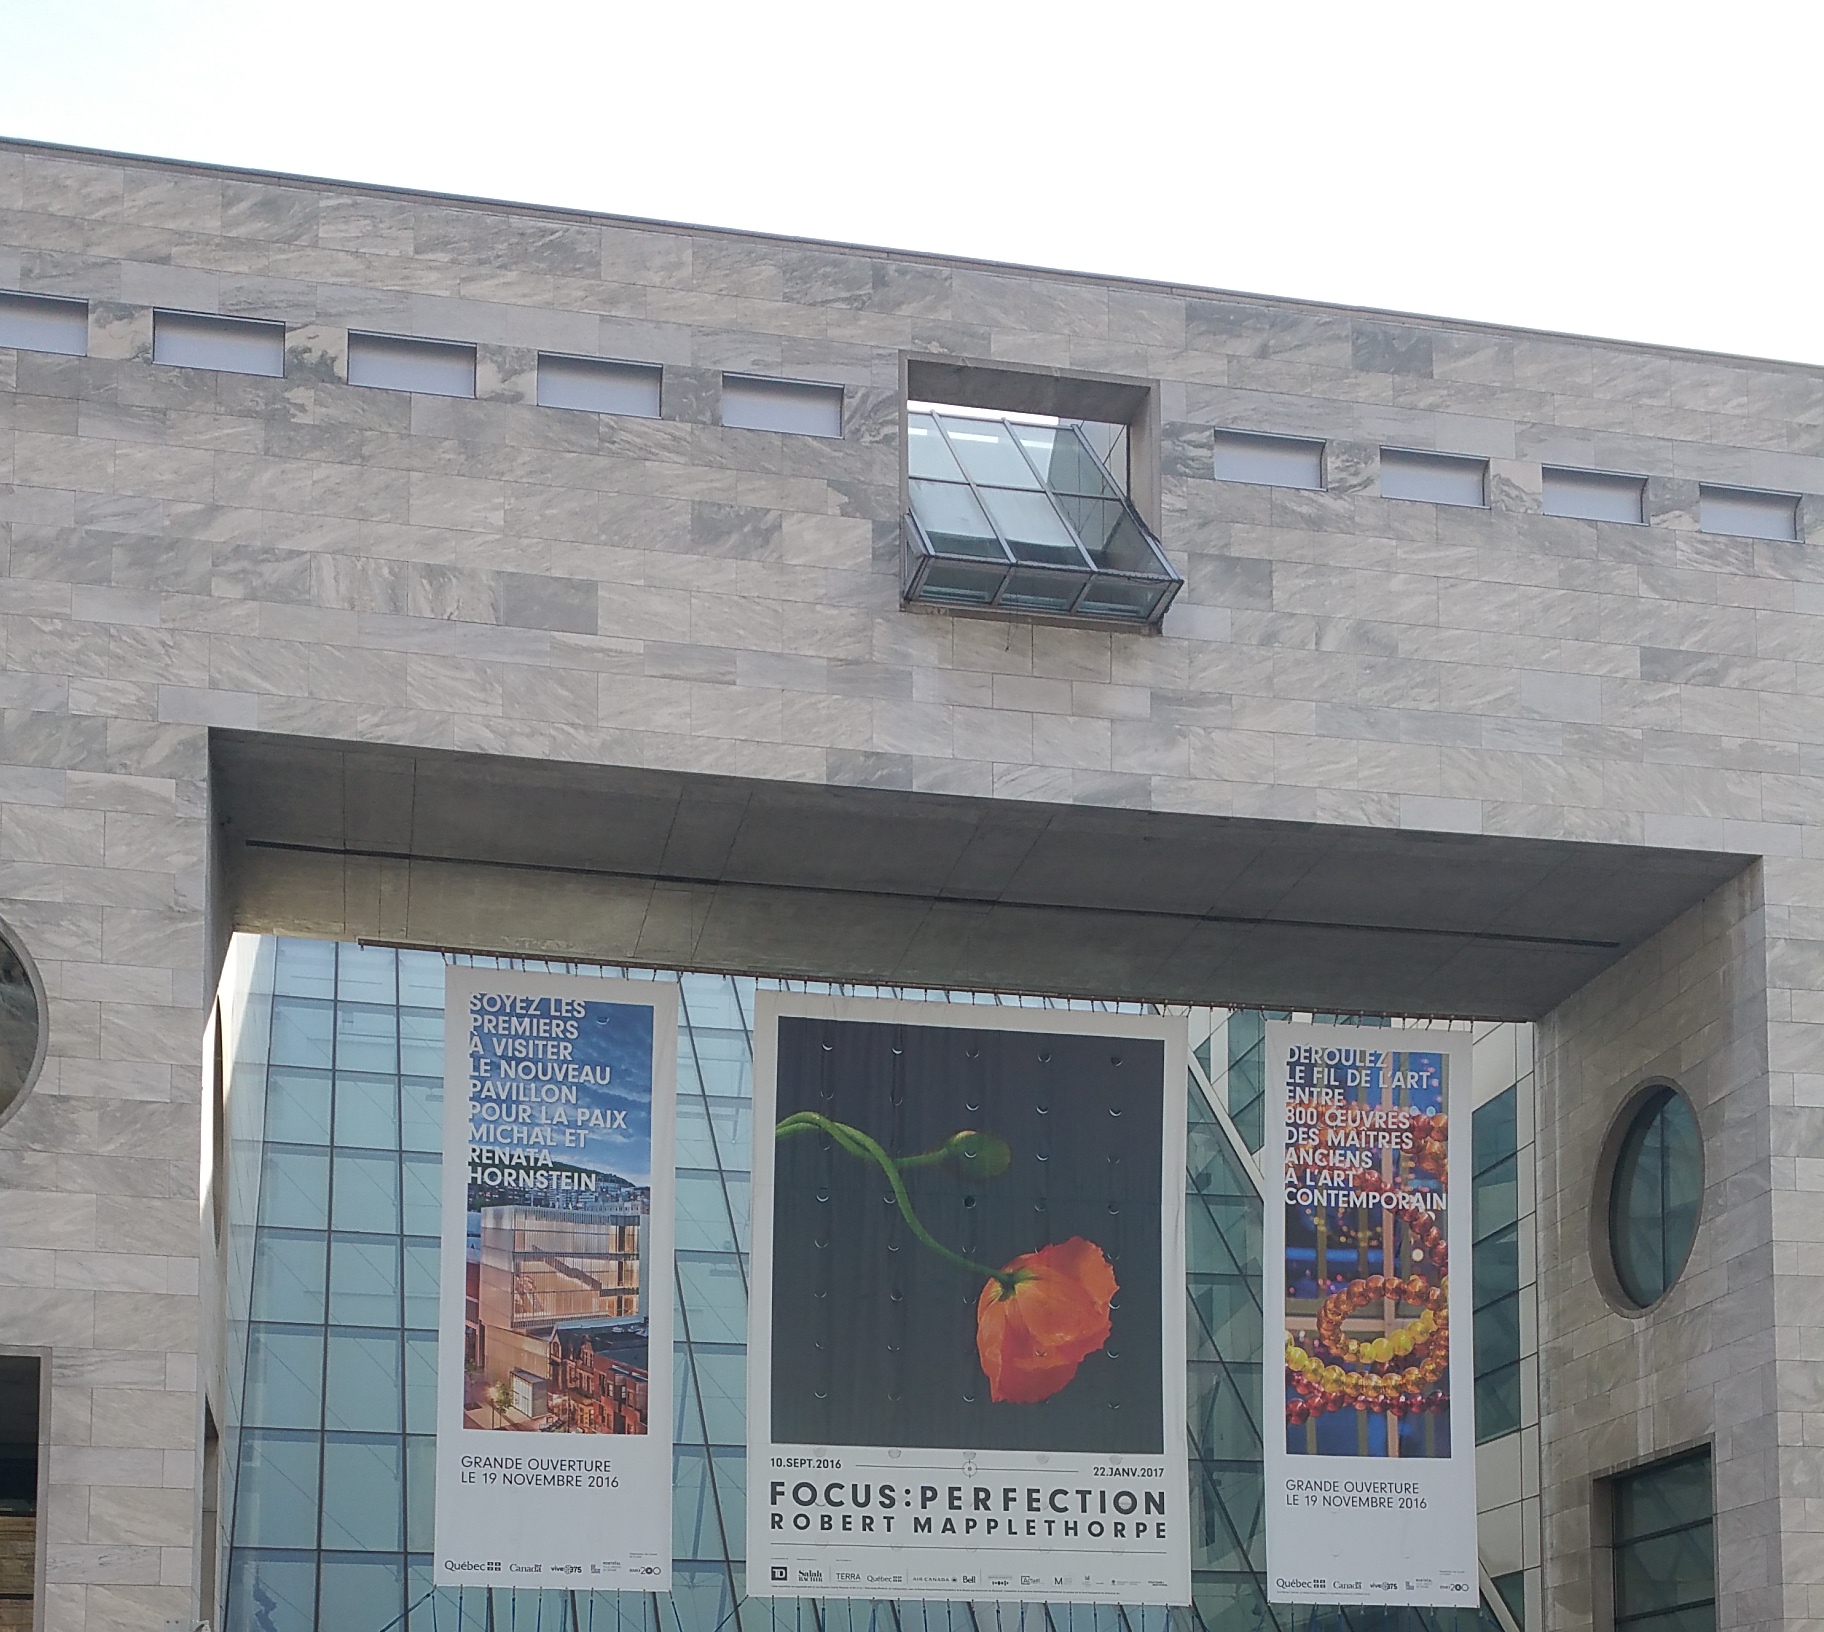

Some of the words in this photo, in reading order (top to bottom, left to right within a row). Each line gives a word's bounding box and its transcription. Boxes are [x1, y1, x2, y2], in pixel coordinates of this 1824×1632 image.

[469, 992, 541, 1014] SOYEZ
[550, 996, 586, 1018] LES
[469, 1014, 579, 1039] PREMIERS
[469, 1030, 484, 1054] À
[492, 1038, 572, 1061] VISITER
[1287, 1042, 1387, 1067] DÉROULEZ
[469, 1058, 491, 1077] LE
[500, 1060, 611, 1085] NOUVEAU
[1286, 1065, 1305, 1083] LE
[1313, 1067, 1339, 1085] FIL
[1347, 1069, 1371, 1087] DE
[1379, 1070, 1430, 1089] L'ART
[469, 1079, 577, 1104] PAVILLON
[1286, 1086, 1344, 1107] ENTRE
[468, 1101, 532, 1123] POUR
[541, 1106, 569, 1126] LA
[577, 1108, 627, 1129] PAIX
[1285, 1107, 1317, 1125] 800
[1325, 1108, 1410, 1130] ŒUVRES
[468, 1124, 557, 1146] MICHAL
[565, 1129, 589, 1148] ET
[1285, 1126, 1319, 1146] DES
[1327, 1127, 1413, 1150] MAÎTRES
[468, 1146, 553, 1168] RENATA
[1285, 1147, 1373, 1169] ANCIENS
[468, 1166, 596, 1191] HORNSTEIN
[1285, 1163, 1299, 1185] À
[1306, 1168, 1357, 1187] L'ART
[1285, 1188, 1447, 1210] CONTEMPORAIN
[461, 1455, 523, 1470] GRANDE
[527, 1458, 611, 1473] OUVERTURE
[770, 1457, 842, 1469] 10.SEPT.2016
[1093, 1466, 1164, 1478] 22.JANV.2017
[461, 1471, 476, 1484] LE
[482, 1472, 497, 1484] 19
[502, 1473, 582, 1487] NOVEMBRE
[588, 1476, 619, 1488] 2016
[1285, 1479, 1339, 1492] GRANDE
[1344, 1481, 1419, 1494] OUVERTURE
[1286, 1494, 1299, 1506] LE
[1305, 1495, 1317, 1506] 19
[1322, 1495, 1393, 1508] NOVEMBRE
[1398, 1498, 1427, 1509] 2016
[771, 1513, 895, 1533] ROBERT
[913, 1516, 1166, 1539] MAPPLETHORPE
[444, 1559, 486, 1571] Québec
[509, 1563, 542, 1573] Canada
[836, 1572, 861, 1580] TERRA
[866, 1575, 892, 1583] Québec
[962, 1575, 976, 1584] Bell
[1276, 1577, 1312, 1590] Québec
[1333, 1580, 1362, 1590] Canada
